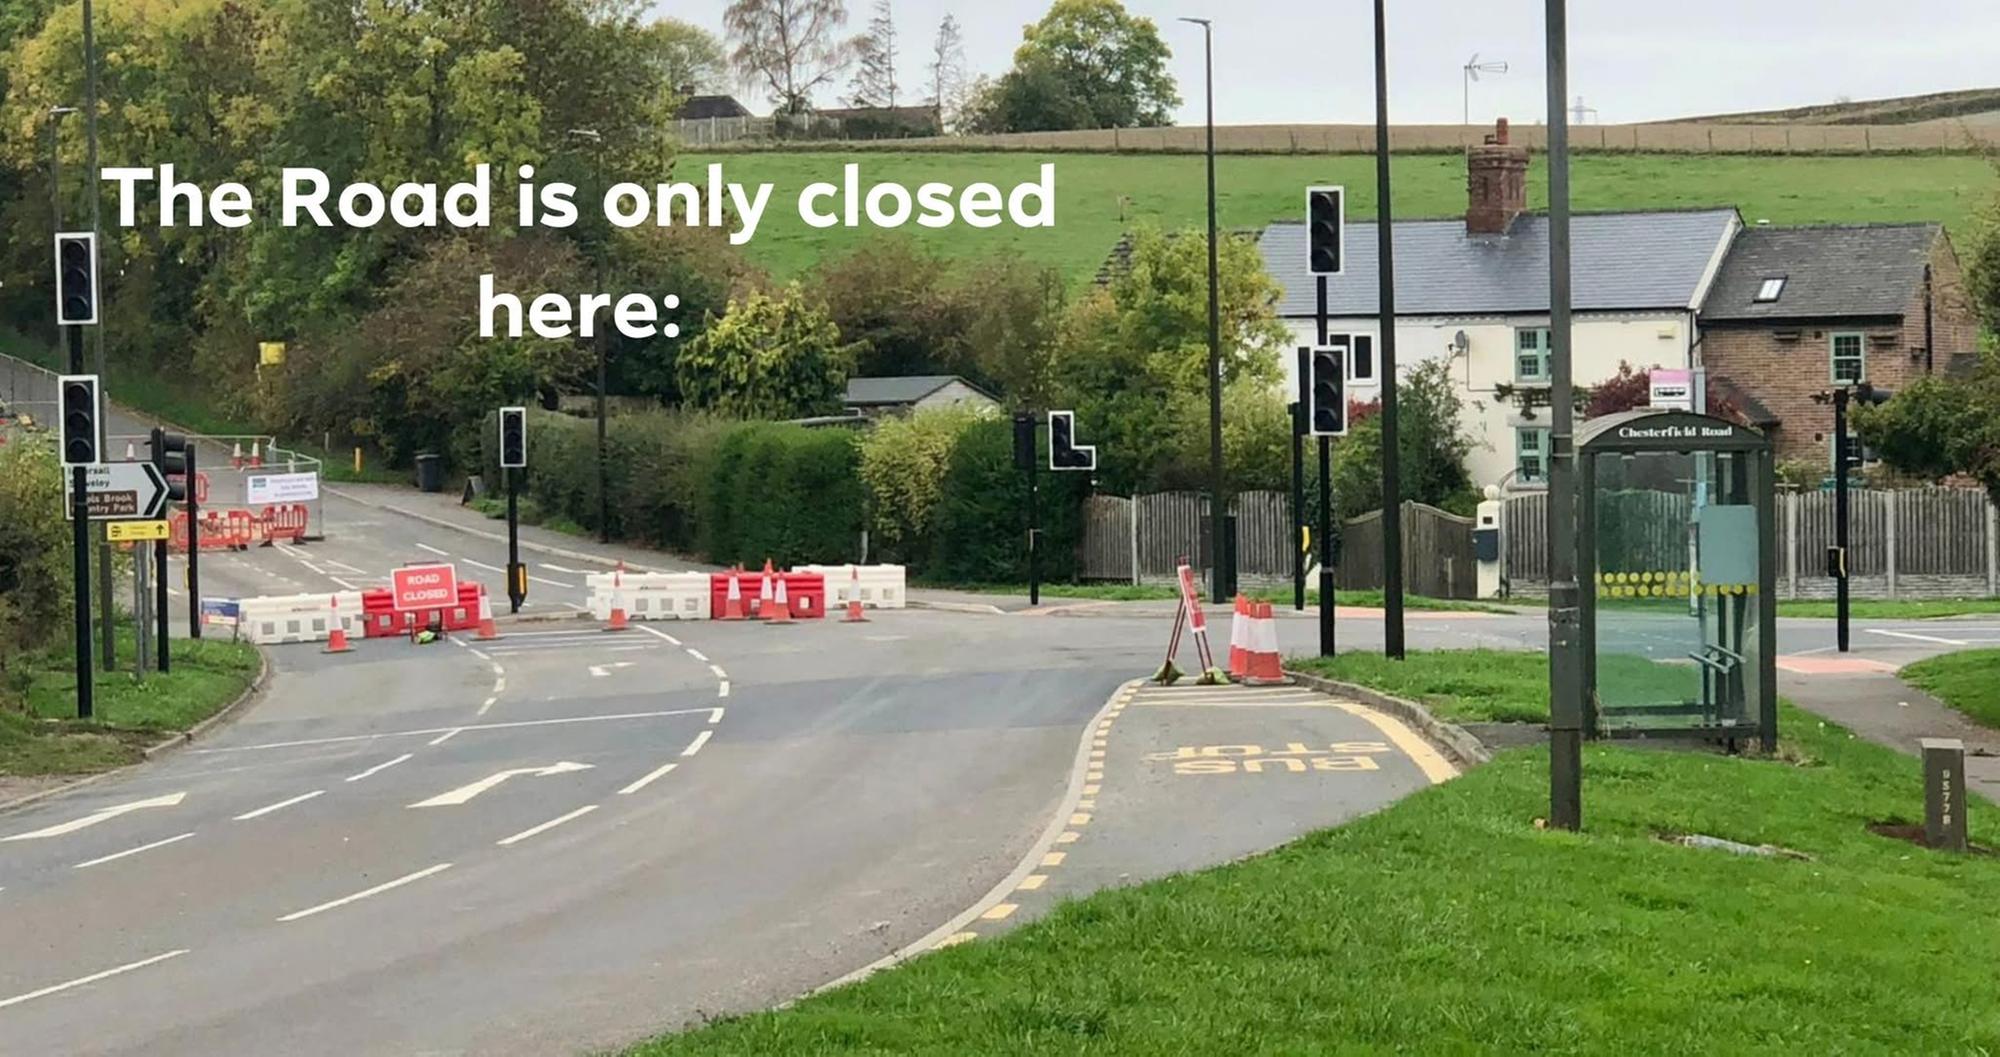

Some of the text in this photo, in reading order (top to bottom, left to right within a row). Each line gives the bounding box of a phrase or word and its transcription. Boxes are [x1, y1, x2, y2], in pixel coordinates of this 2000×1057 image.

[1619, 426, 1733, 438] Chesterfield Road
[103, 493, 133, 502] Brook
[112, 503, 135, 512] Park
[406, 573, 441, 586] ROAD
[402, 588, 449, 602] CLOSED
[1174, 756, 1380, 775] BUS
